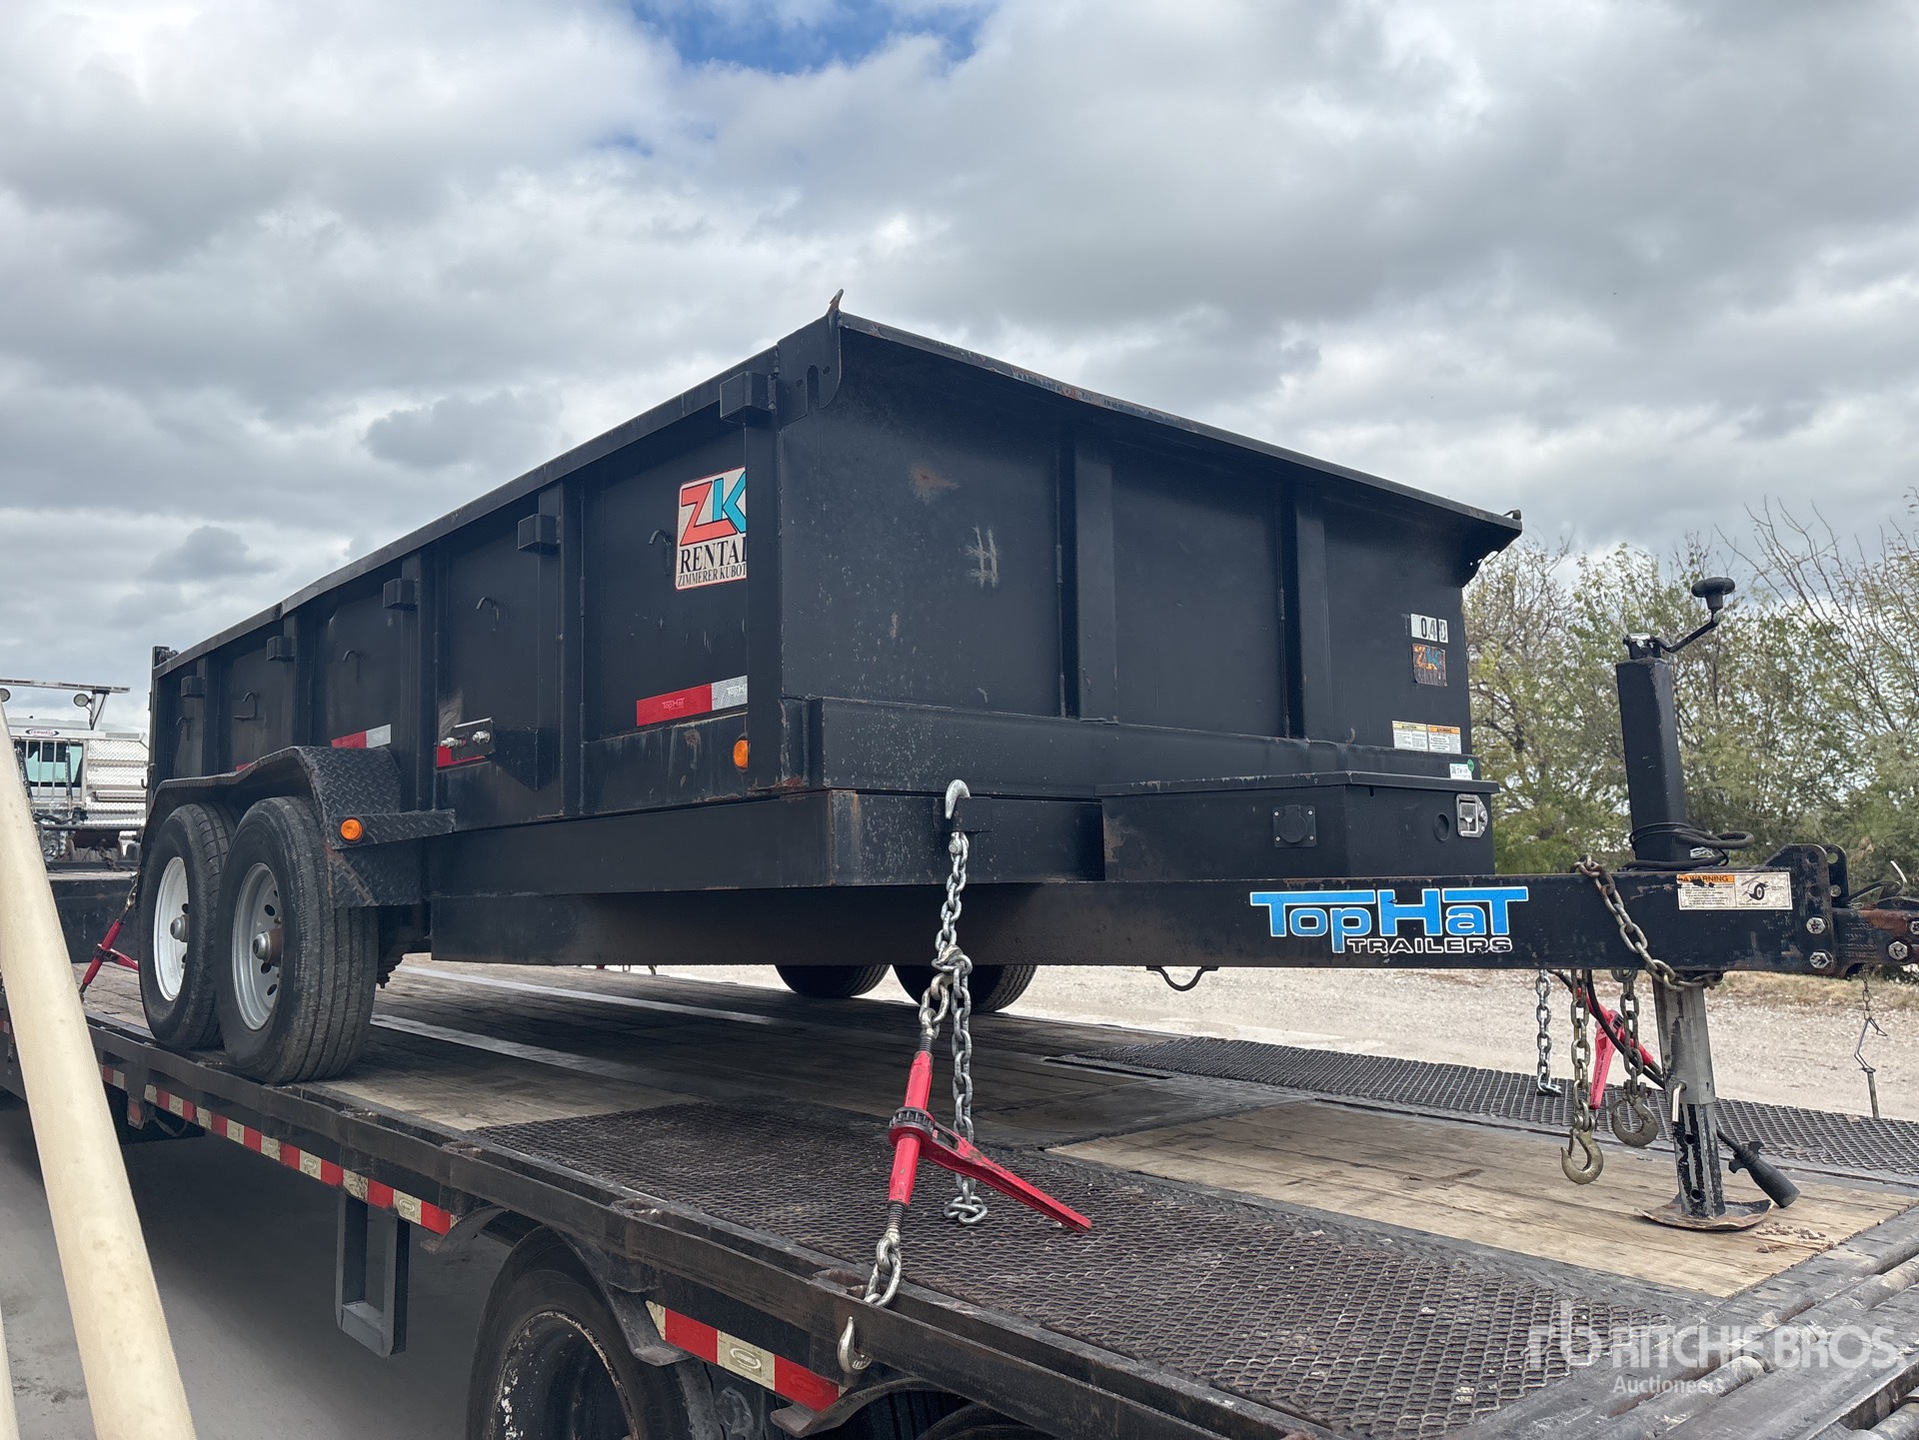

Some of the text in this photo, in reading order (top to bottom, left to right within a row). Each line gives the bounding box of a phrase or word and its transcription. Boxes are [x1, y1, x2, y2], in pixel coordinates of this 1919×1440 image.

[680, 472, 746, 546] ZK
[678, 569, 718, 587] ZIMMERER
[1347, 937, 1513, 954] TRAILERS
